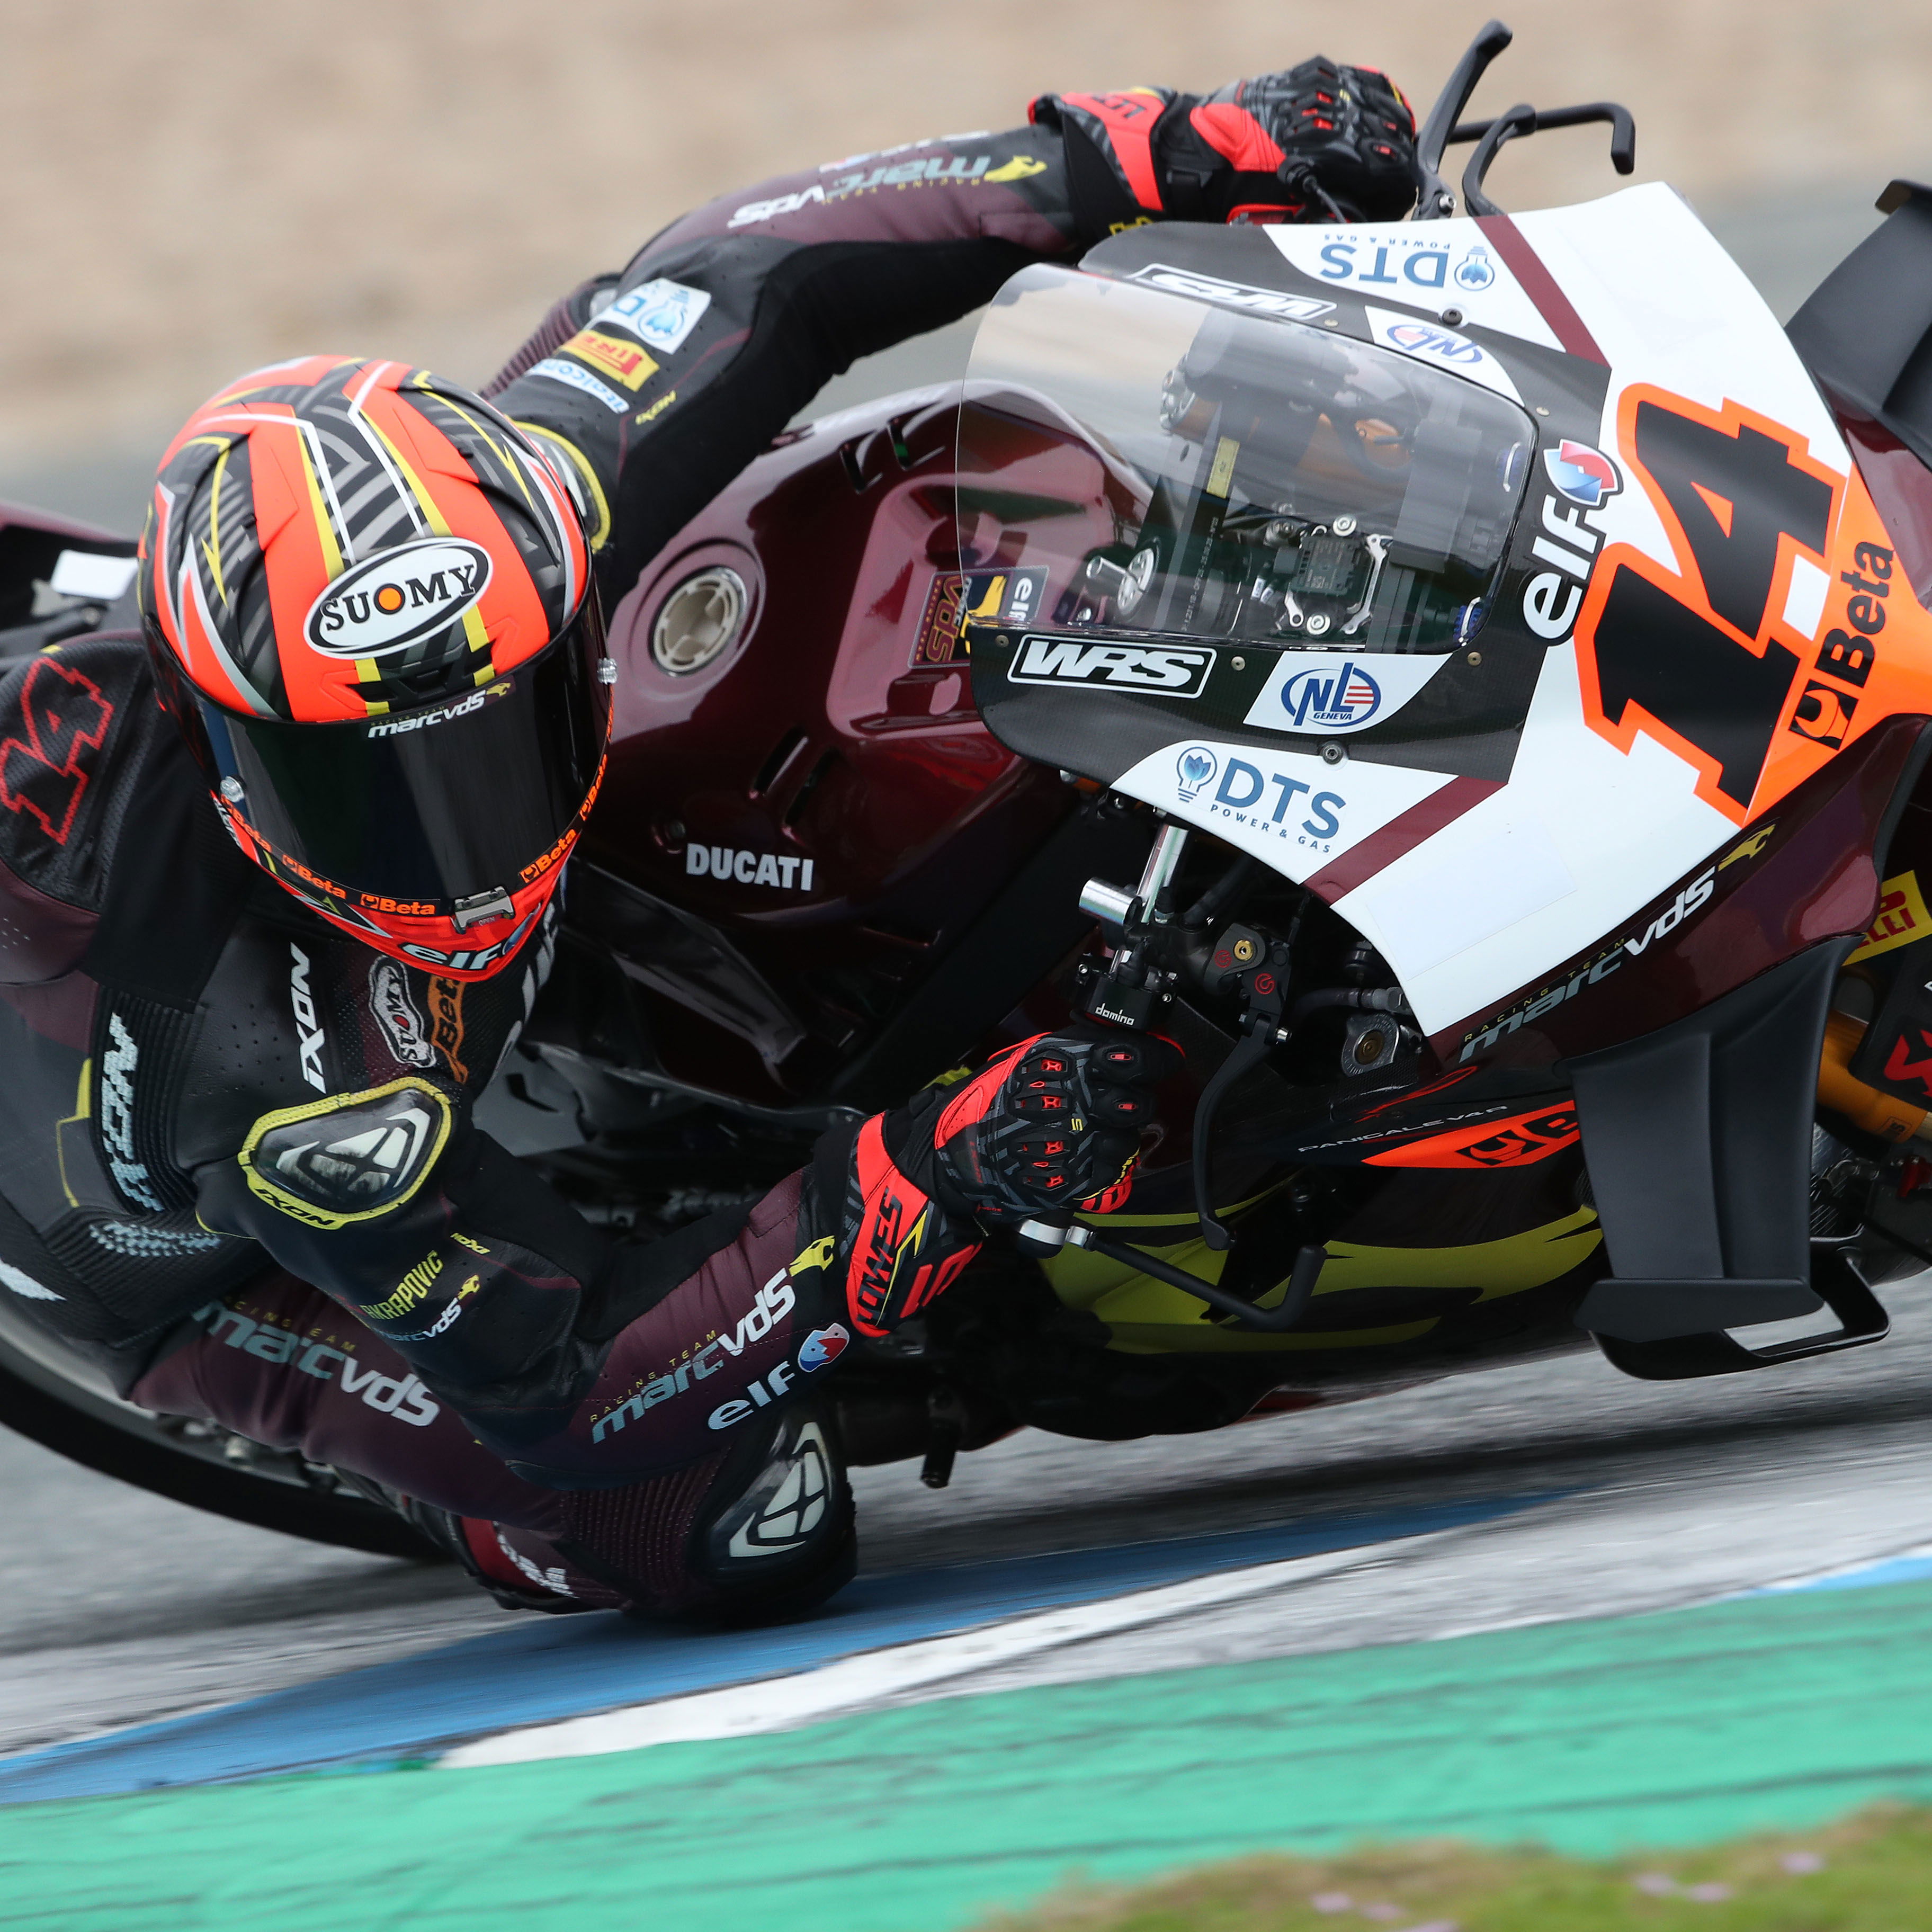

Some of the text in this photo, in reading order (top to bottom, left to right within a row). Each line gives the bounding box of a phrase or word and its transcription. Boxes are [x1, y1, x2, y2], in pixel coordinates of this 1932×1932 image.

[1324, 233, 1362, 243] GAS
[1389, 239, 1451, 249] POWER
[1321, 244, 1449, 288] DTS
[1152, 273, 1307, 316] WRS
[1523, 494, 1600, 639] elf
[319, 564, 477, 631] SUOMY
[1578, 387, 1843, 824] 14
[1815, 541, 1895, 688] Beta
[1019, 641, 1205, 687] WRS
[368, 690, 486, 738] marcvds
[1293, 663, 1359, 726] NL
[1313, 711, 1353, 721] GENEVA
[0, 657, 114, 846] 14
[1215, 757, 1347, 839] DTS
[535, 829, 577, 873] Beta
[1211, 803, 1269, 832] POWER
[1298, 835, 1331, 853] GAS
[298, 864, 347, 899] Beta
[686, 843, 814, 891] DUCATI
[380, 899, 436, 916] Beta
[478, 917, 496, 926] OPEN
[401, 943, 502, 970] elf
[1459, 865, 1716, 1063] marcvds
[435, 977, 461, 1049] Bet
[1094, 1003, 1135, 1026] domino
[1464, 938, 1625, 1042] RACING TEAM
[290, 942, 326, 1094] IXON
[256, 1188, 333, 1227] IXON
[856, 1185, 903, 1326] LOWES
[590, 1329, 717, 1423] RACING TEAM
[592, 1267, 795, 1444] marcvds
[708, 1360, 795, 1430] elf
